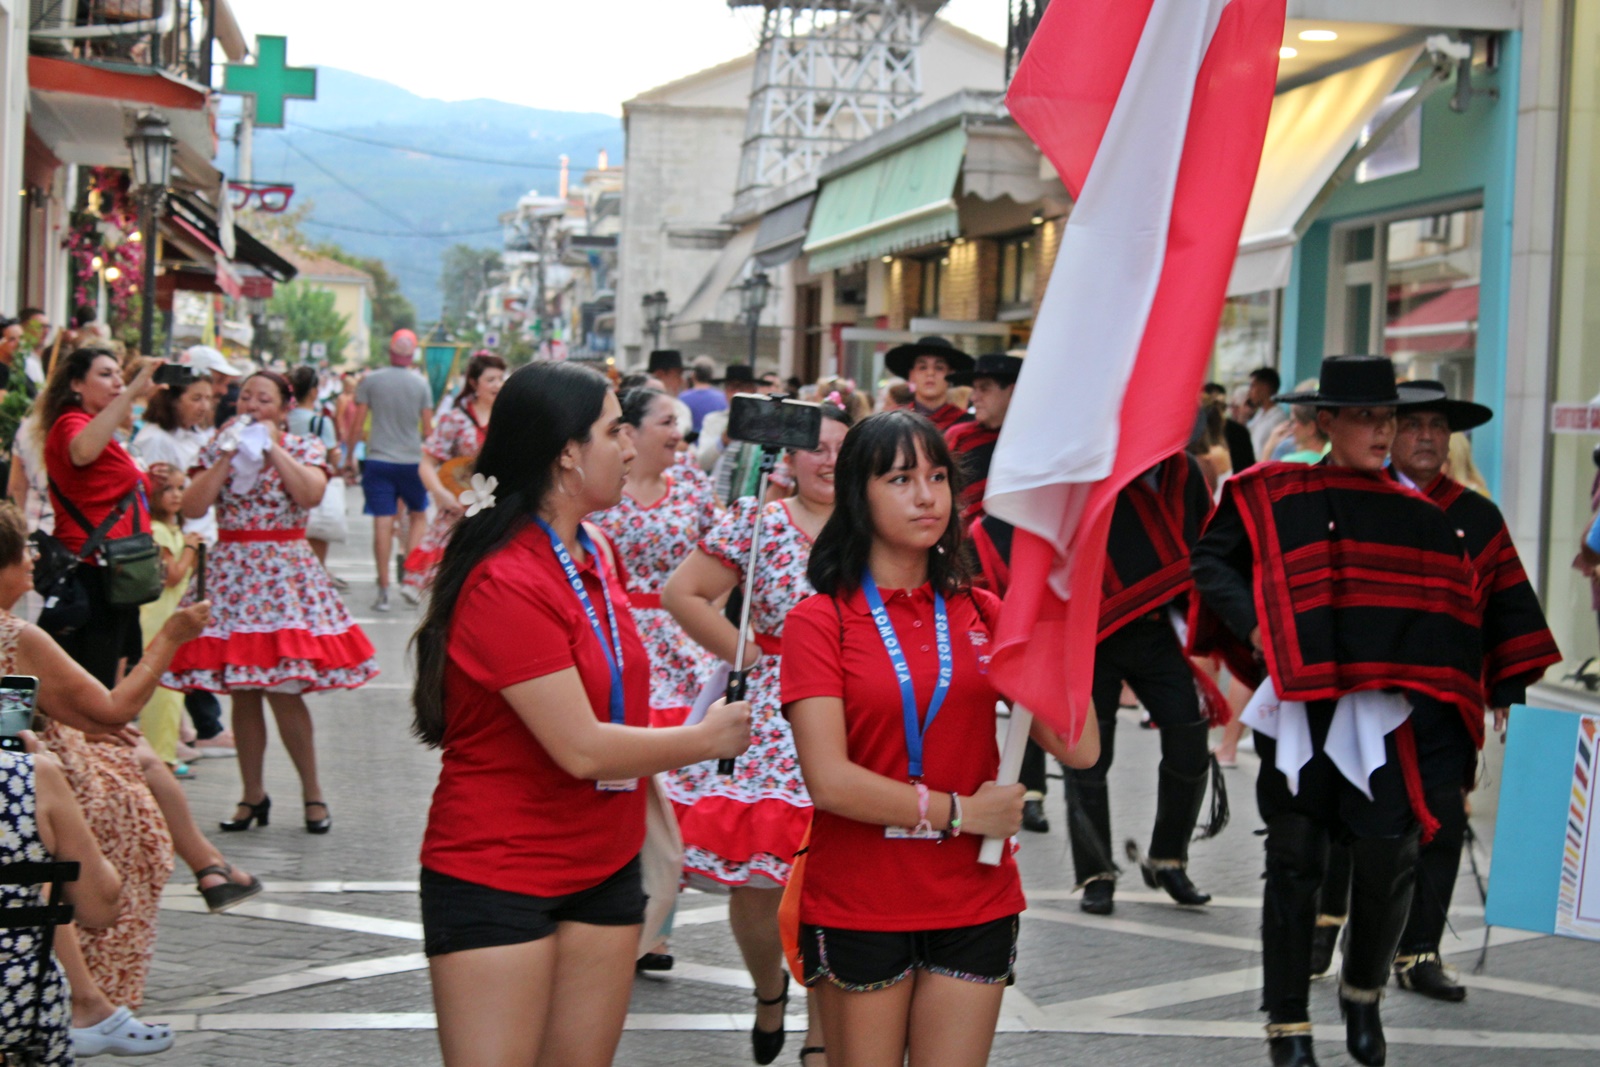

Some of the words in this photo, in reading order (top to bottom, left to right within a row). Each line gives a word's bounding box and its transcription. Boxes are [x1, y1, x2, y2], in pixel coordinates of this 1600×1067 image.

[553, 542, 589, 601] SOMOS
[586, 606, 600, 628] UA
[872, 606, 901, 656] SOMOS
[895, 662, 911, 684] UA
[935, 613, 951, 661] SOMOS
[939, 667, 952, 687] UA
